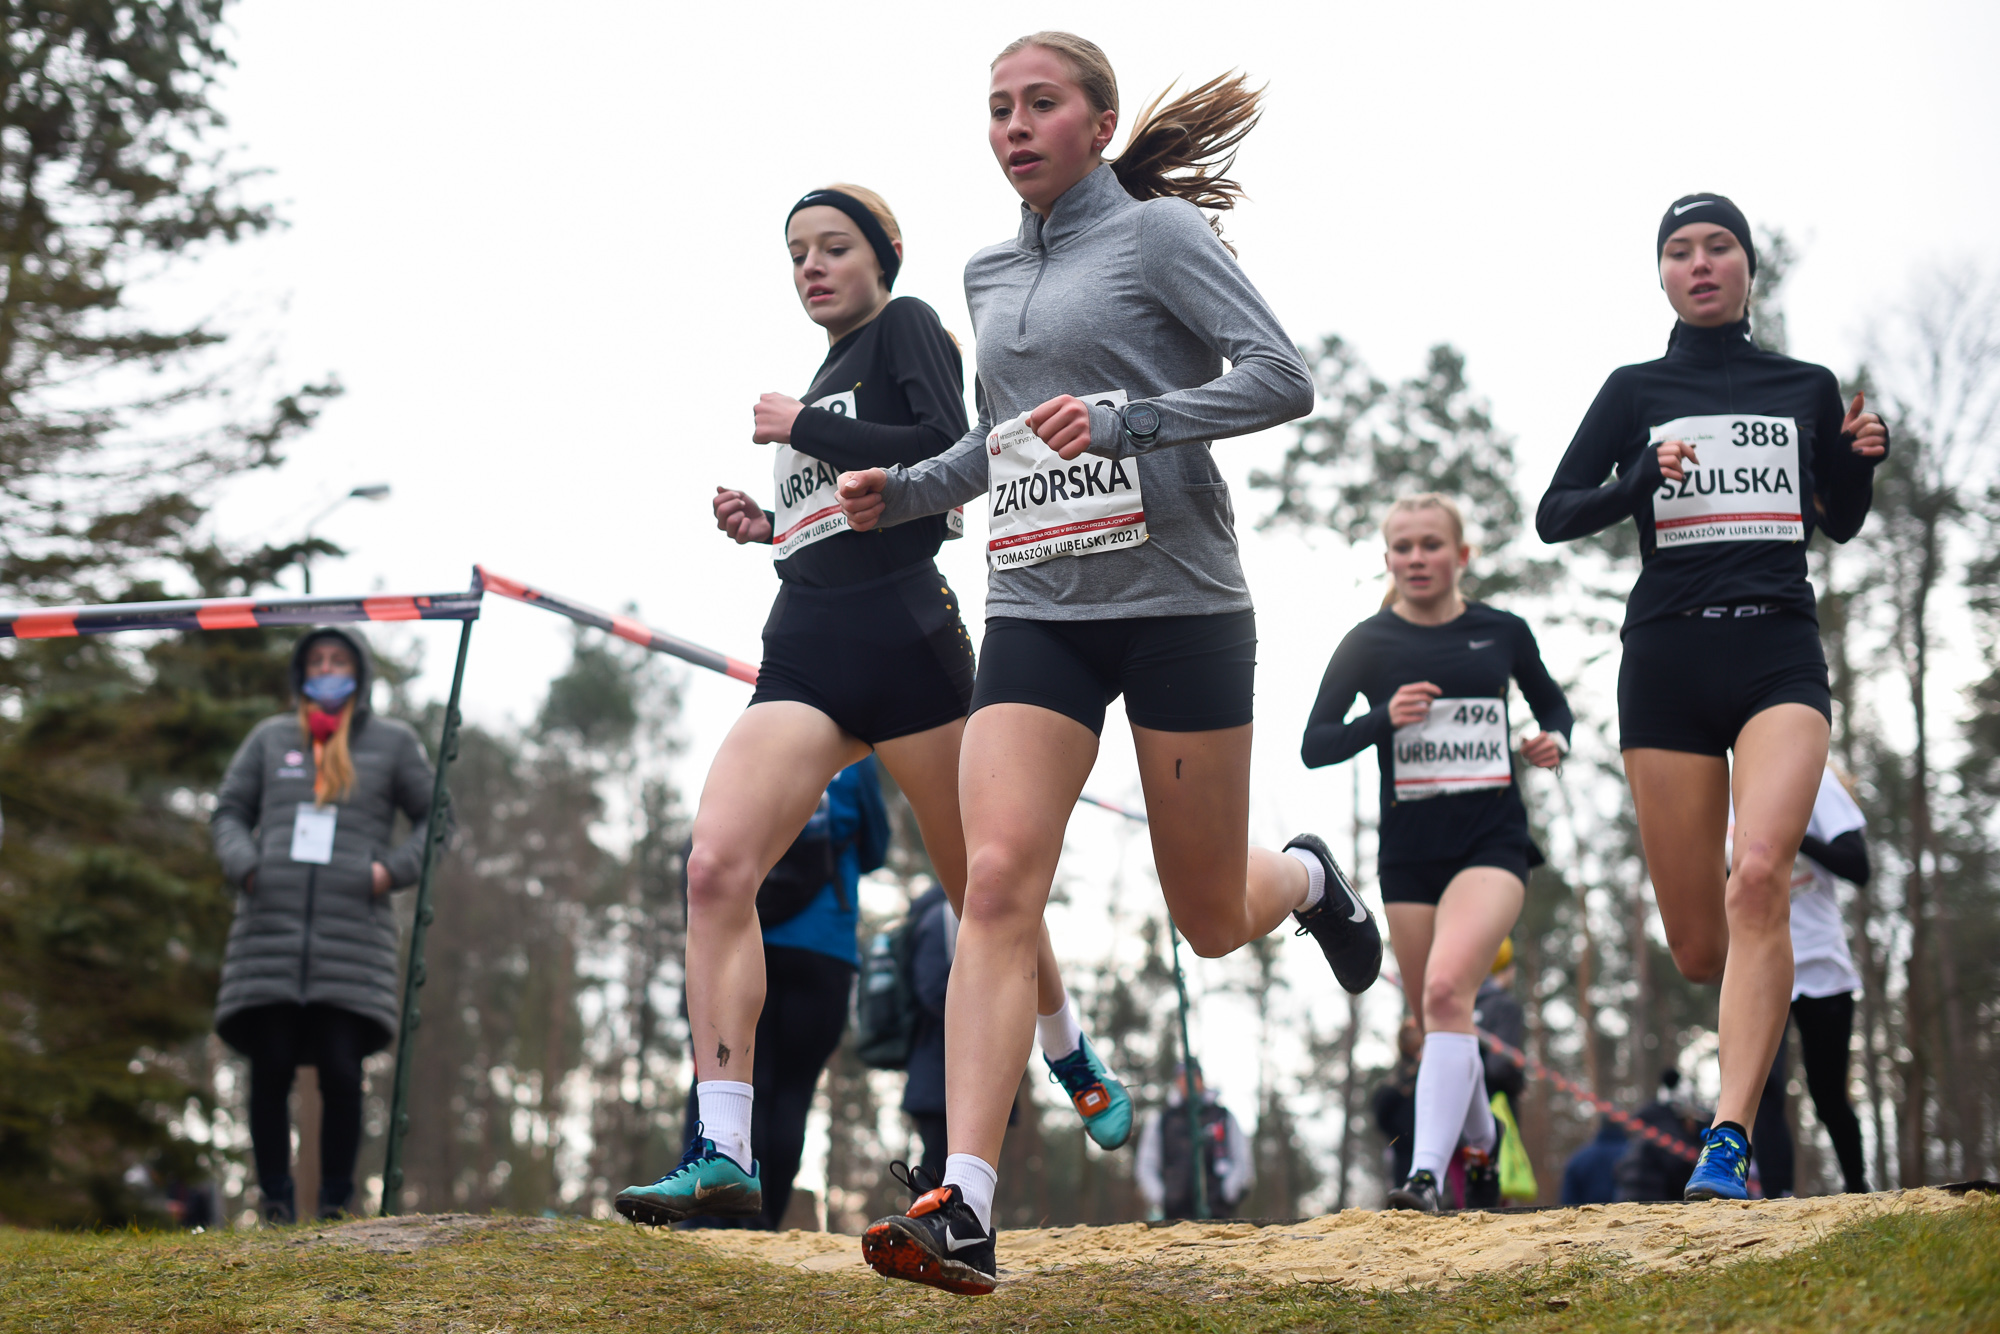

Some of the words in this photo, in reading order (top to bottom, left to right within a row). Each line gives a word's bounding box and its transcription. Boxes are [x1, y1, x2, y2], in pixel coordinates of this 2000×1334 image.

[1731, 420, 1789, 447] 388
[993, 460, 1132, 517] ZATORSKA
[1660, 466, 1793, 501] SZULSKA
[812, 516, 847, 537] LUBELSKI
[1664, 523, 1725, 542] TOMASZÓW
[1729, 524, 1774, 536] LUBELSKI
[1777, 525, 1798, 536] 2021
[997, 544, 1052, 565] TOMASZÓW
[1055, 534, 1107, 554] LUBELSKI
[1109, 528, 1140, 545] 2021
[1453, 704, 1499, 725] 496
[1399, 740, 1502, 764] URBANIAK
